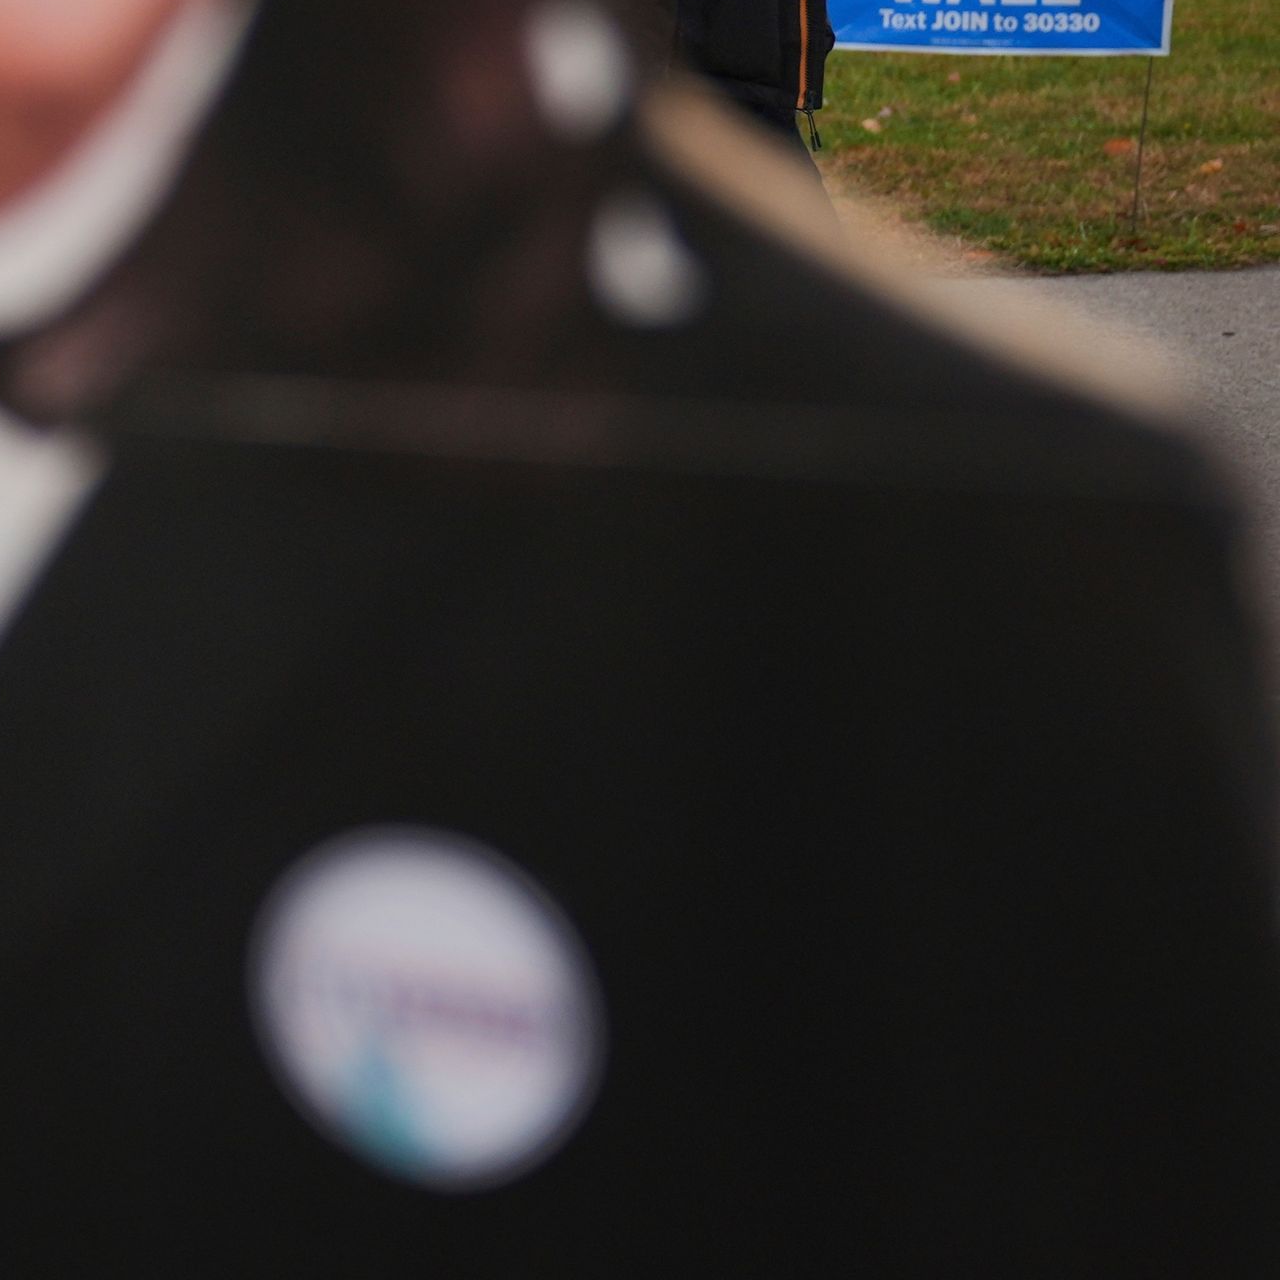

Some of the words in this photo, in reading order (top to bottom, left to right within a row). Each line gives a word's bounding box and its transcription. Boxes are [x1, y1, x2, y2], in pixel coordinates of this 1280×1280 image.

[879, 8, 927, 31] Text
[931, 10, 988, 32] JOIN
[994, 13, 1018, 32] to
[1024, 13, 1100, 32] 30330
